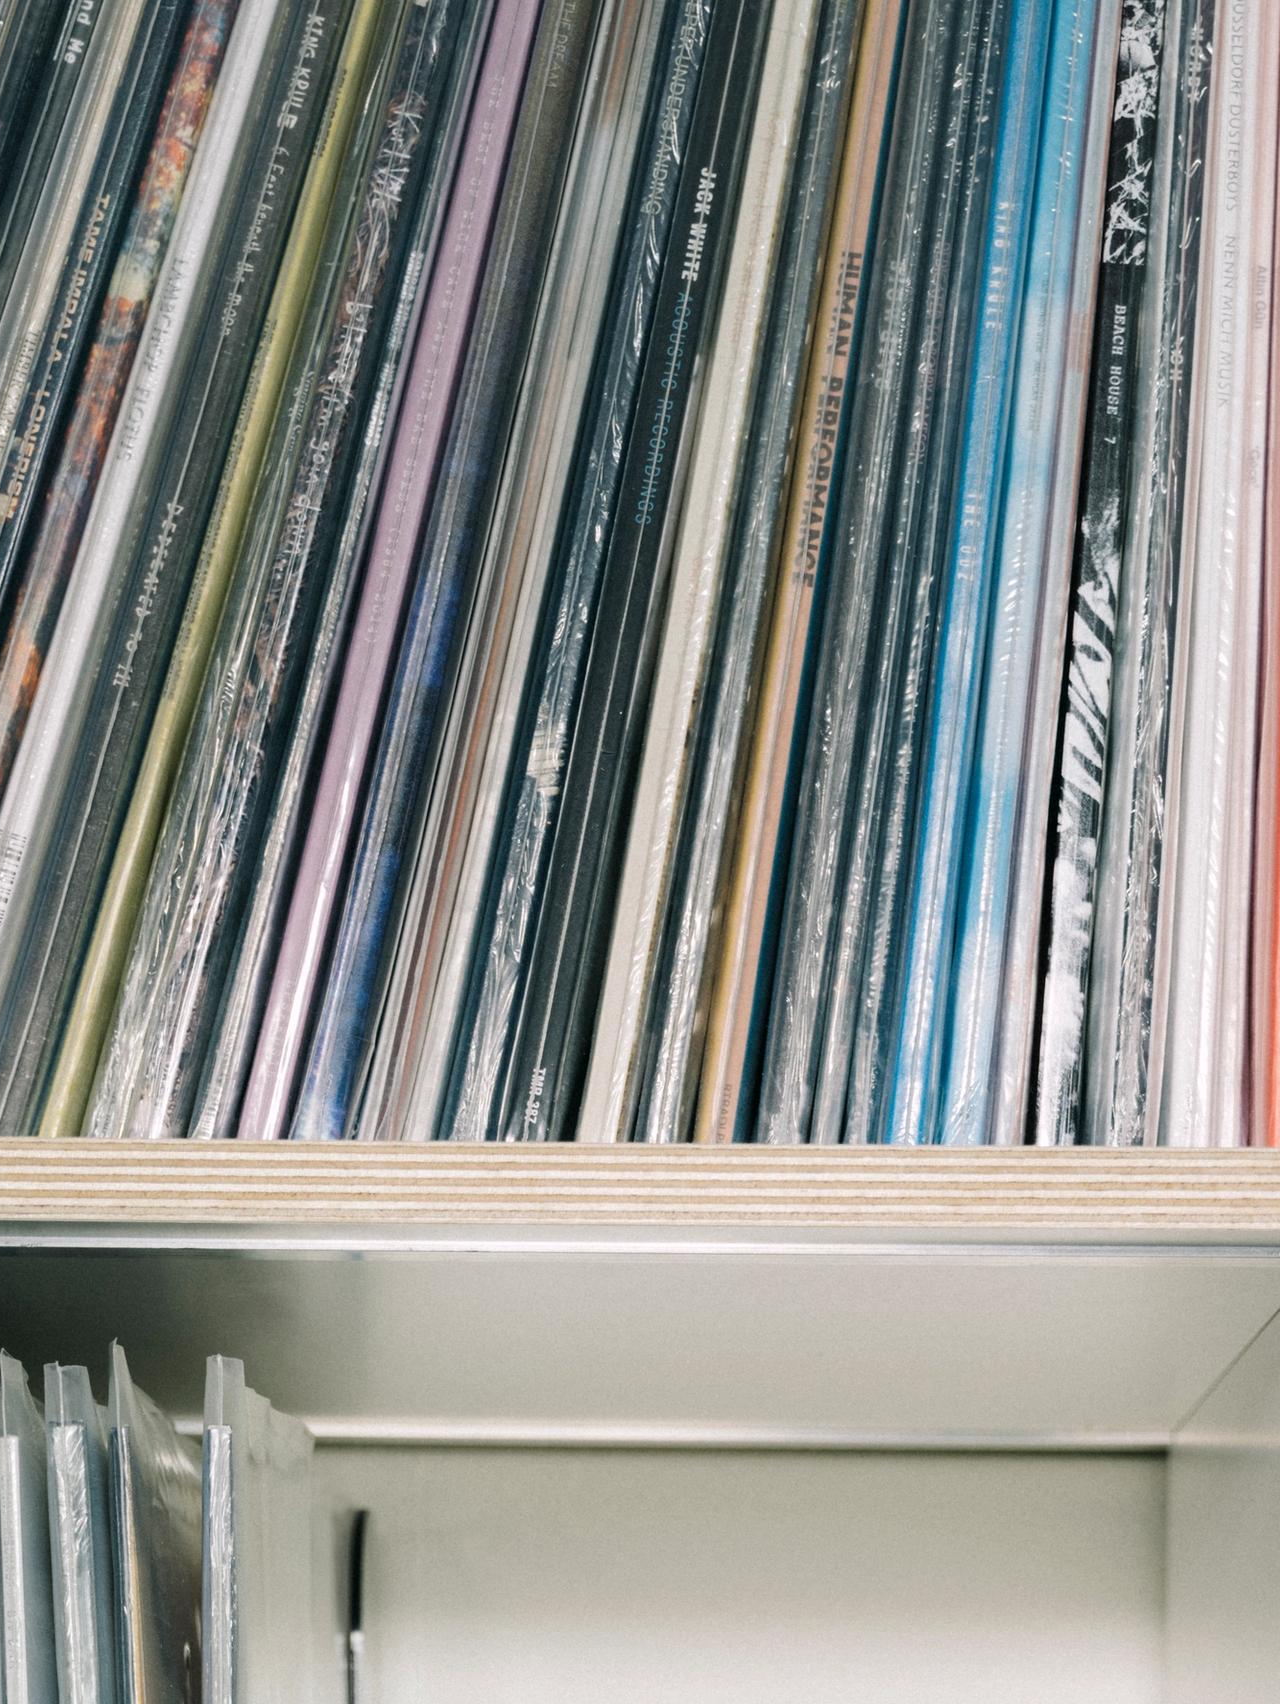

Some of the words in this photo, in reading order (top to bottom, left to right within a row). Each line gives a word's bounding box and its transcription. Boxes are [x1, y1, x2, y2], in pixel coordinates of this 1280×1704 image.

[298, 14, 326, 60] KING
[277, 67, 311, 129] KRULE
[693, 167, 717, 213] JACK
[681, 222, 708, 282] WHITE
[828, 251, 862, 357] HUMAN
[1110, 304, 1127, 356] BEACH
[661, 292, 695, 389] ACOUSTIC
[1105, 365, 1123, 416] HOUSE
[634, 398, 678, 525] RECORDINGS
[1103, 436, 1116, 444] 7
[791, 375, 844, 588] PERFORMANCE
